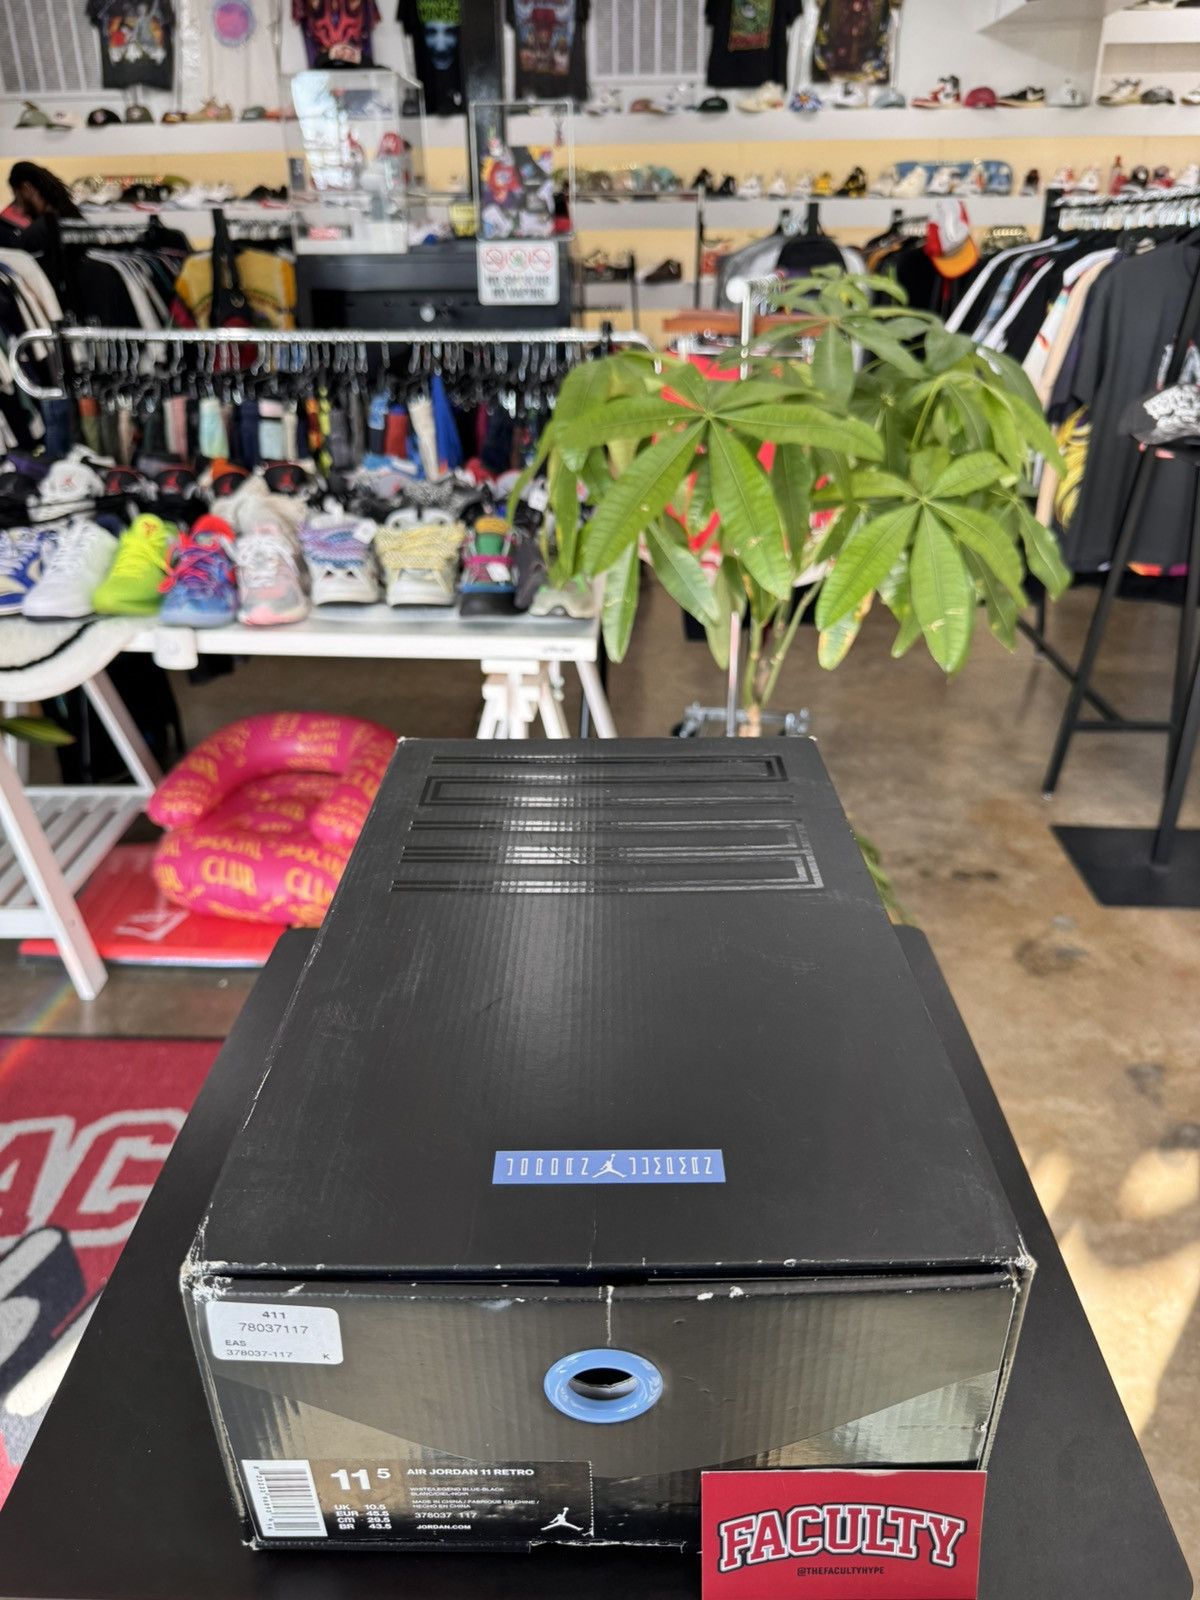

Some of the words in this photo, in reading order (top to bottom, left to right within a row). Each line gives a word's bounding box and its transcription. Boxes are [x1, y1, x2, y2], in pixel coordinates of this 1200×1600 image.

[262, 1311, 287, 1320] 411
[239, 1322, 309, 1334] 78037117
[225, 1339, 247, 1347] EAS
[226, 1349, 293, 1358] 378037-117
[407, 1468, 427, 1476] AIR
[429, 1468, 479, 1476] JORDAN
[480, 1468, 492, 1476] 11
[493, 1468, 535, 1476] RETRO
[330, 1469, 371, 1491] 11
[376, 1468, 392, 1479] 5
[364, 1503, 387, 1511] 10.5
[717, 1502, 967, 1574] FACULTY
[797, 1566, 886, 1577] @THEFACULTYHYPE
